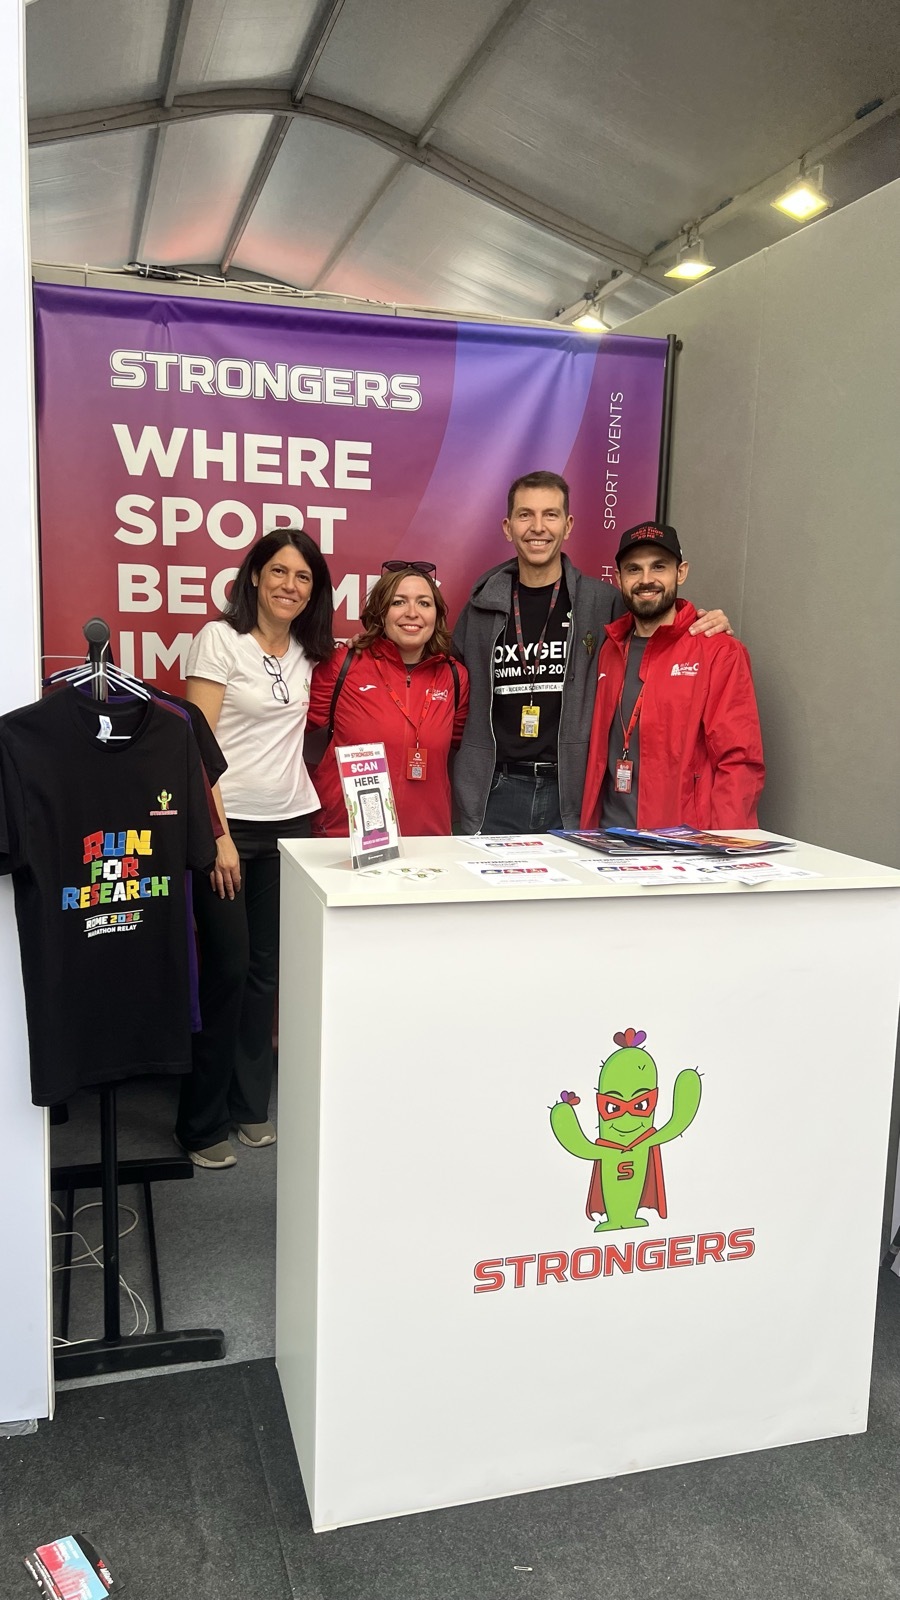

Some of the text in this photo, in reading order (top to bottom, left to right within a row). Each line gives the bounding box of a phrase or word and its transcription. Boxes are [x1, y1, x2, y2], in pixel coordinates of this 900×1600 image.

[110, 348, 422, 412] STRONGERS
[112, 423, 373, 492] WHERE
[604, 392, 624, 530] SPORT EVENTS
[113, 494, 347, 555] SPORT
[495, 666, 522, 678] SWIM
[524, 665, 547, 676] CUP
[350, 763, 379, 773] SCAN
[353, 776, 380, 787] HERE
[83, 829, 153, 864] RUN
[91, 856, 139, 884] FOR
[61, 876, 169, 911] RESEARCH
[86, 911, 141, 930] ROME 2026
[87, 924, 137, 939] MARATHON RELAY
[616, 1160, 635, 1181] S
[473, 1227, 756, 1294] STRONGERS
